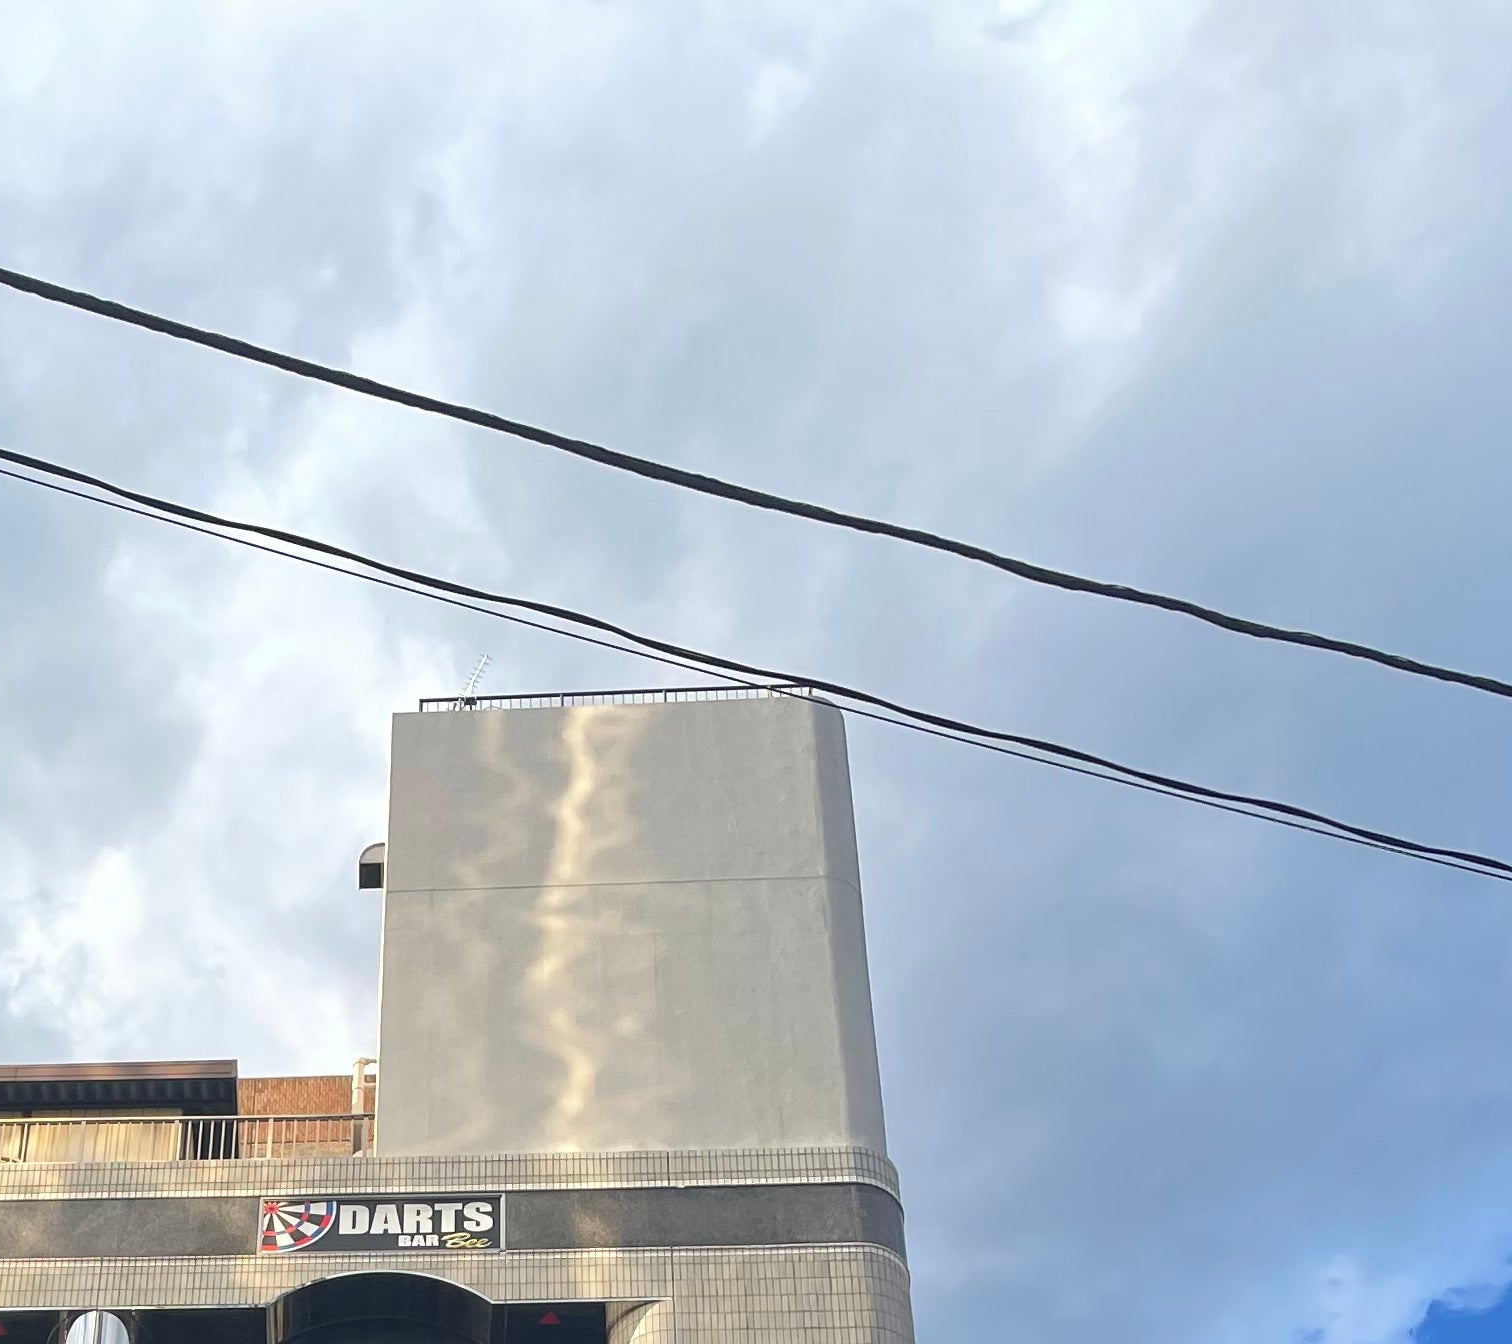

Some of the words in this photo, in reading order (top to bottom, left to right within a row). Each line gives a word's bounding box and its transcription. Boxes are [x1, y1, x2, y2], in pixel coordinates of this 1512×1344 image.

[339, 1201, 493, 1235] DARTS
[398, 1234, 439, 1247] BAR
[441, 1232, 492, 1248] Bee
